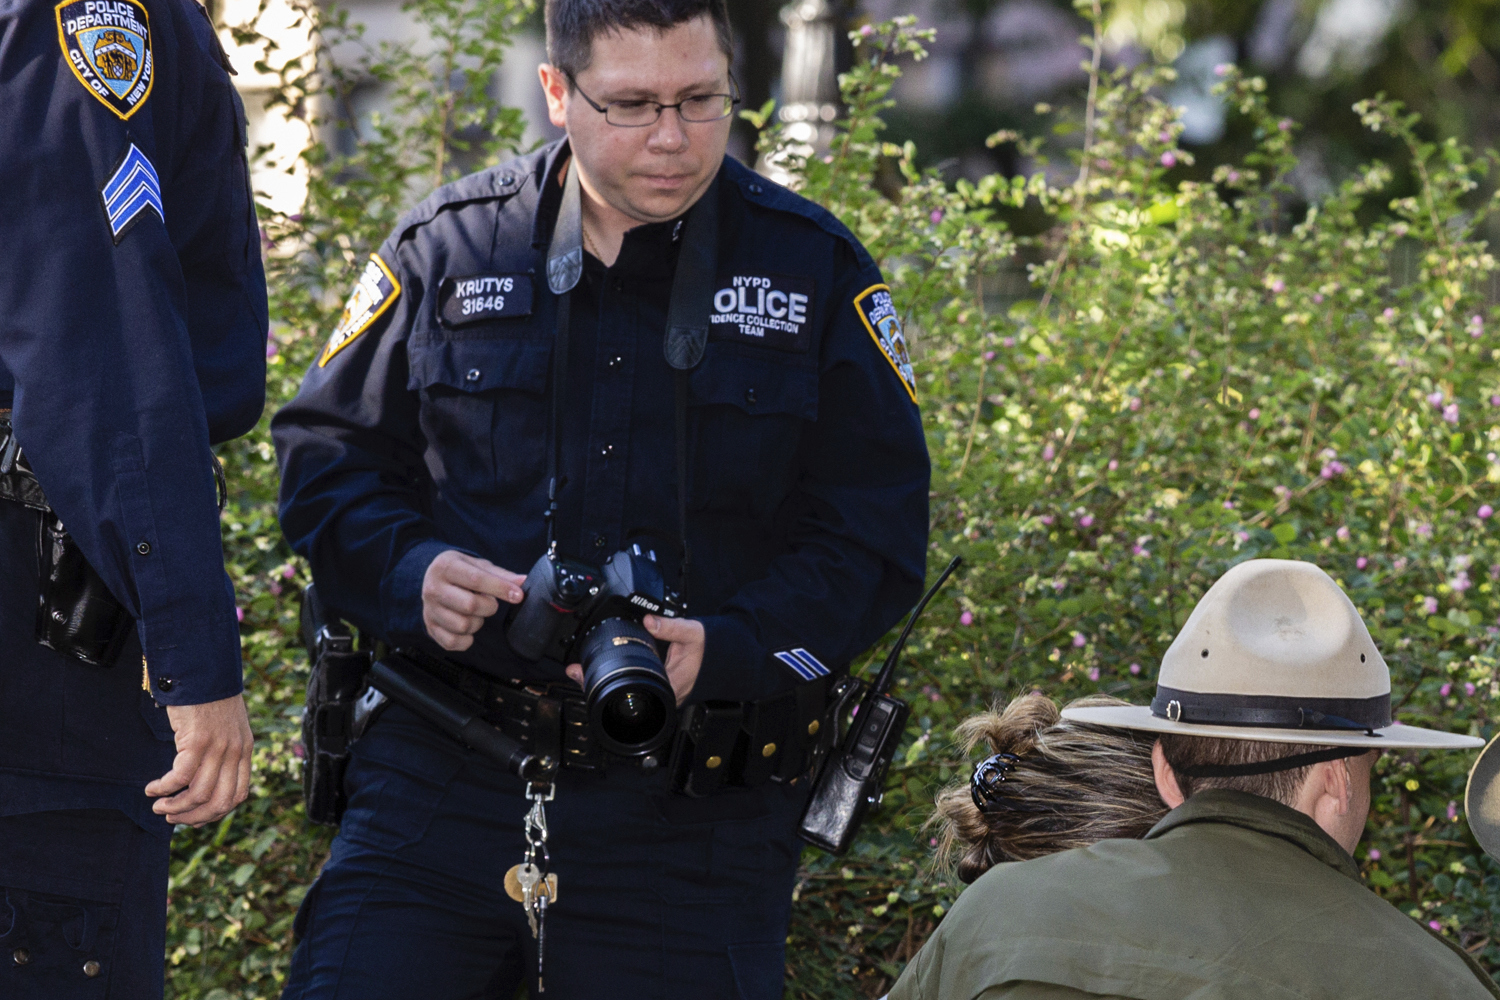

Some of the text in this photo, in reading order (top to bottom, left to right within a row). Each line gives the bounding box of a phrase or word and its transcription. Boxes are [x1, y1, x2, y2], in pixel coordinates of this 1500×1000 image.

[85, 1, 135, 19] POLICE
[66, 13, 148, 40] DEPARTMENT
[69, 49, 110, 97] CITY OF
[126, 48, 152, 106] NEW YORK
[455, 277, 514, 298] KRUTYS
[733, 276, 771, 289] NYPD
[461, 295, 505, 315] 31646
[713, 286, 808, 324] OLICE
[709, 313, 799, 335] IDENCE COLLECTION
[738, 323, 765, 337] TEAM
[630, 595, 660, 612] Nikon
